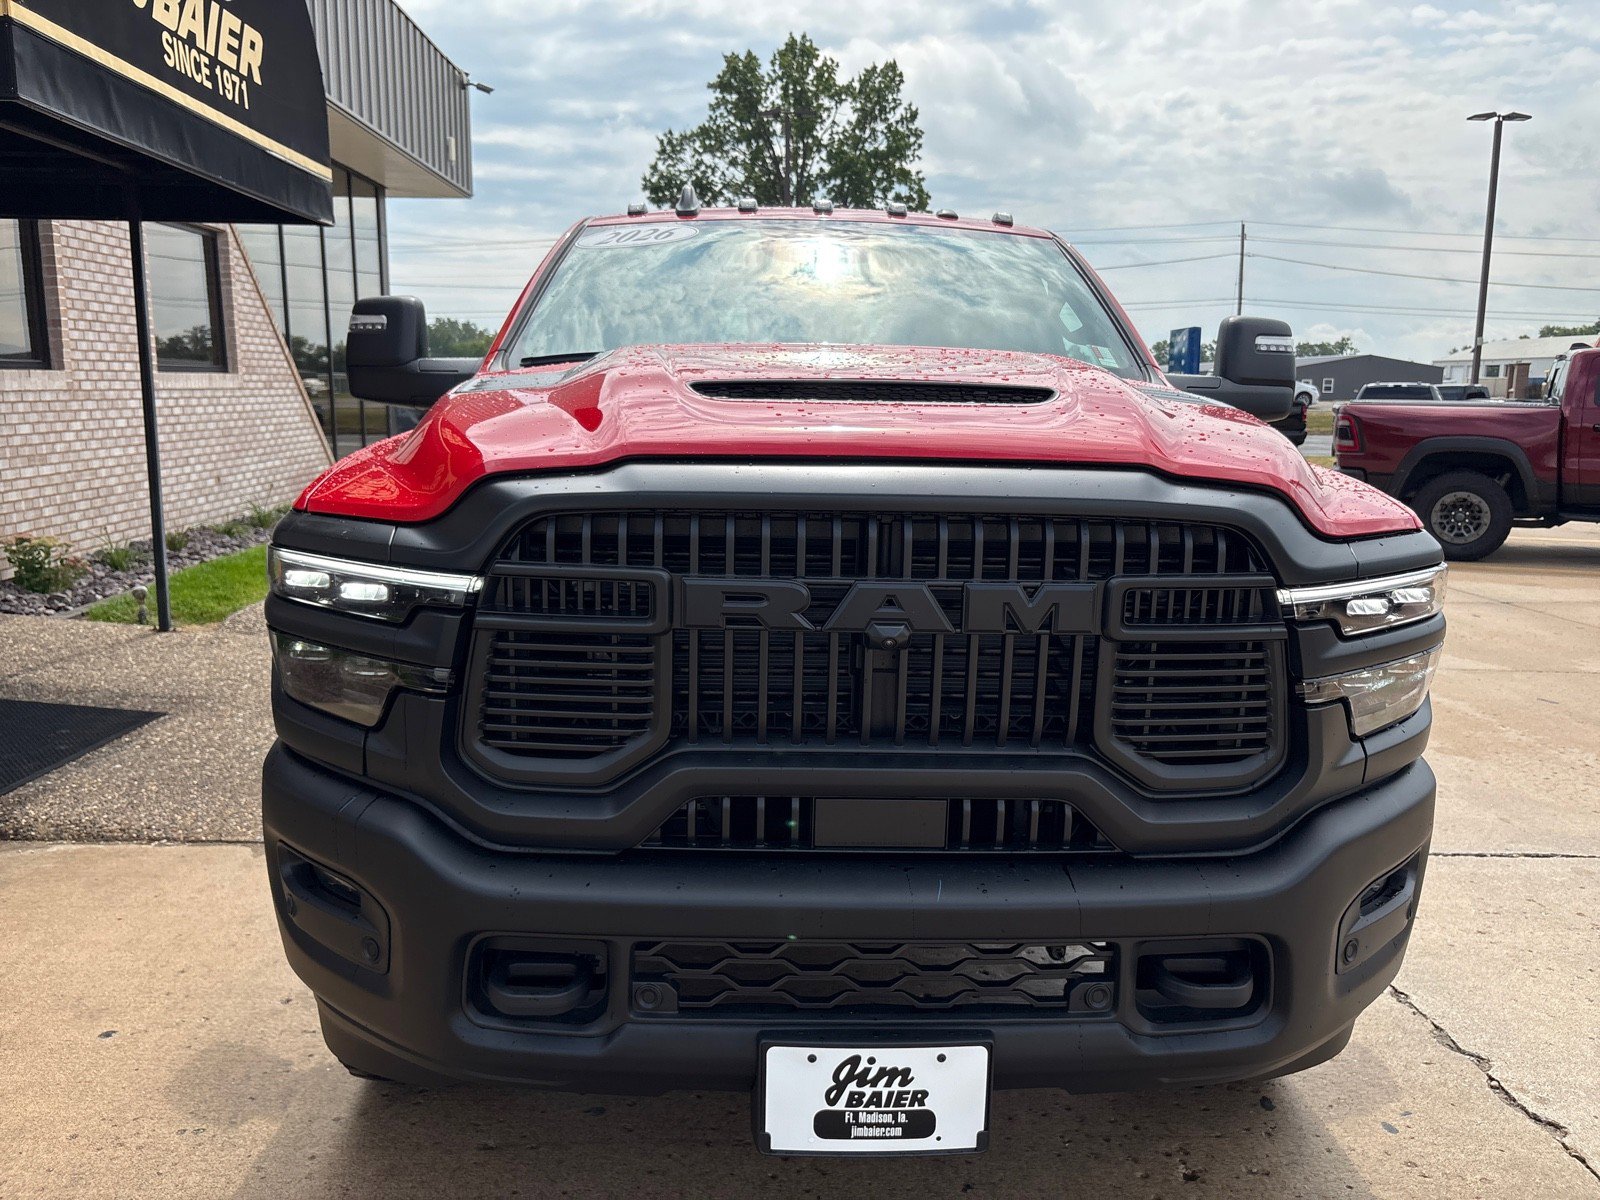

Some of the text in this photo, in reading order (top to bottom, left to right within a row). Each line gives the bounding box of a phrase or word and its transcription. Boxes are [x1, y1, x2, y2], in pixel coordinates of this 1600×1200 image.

[152, 0, 264, 86] BAIER
[161, 30, 249, 110] SINCE 1971
[594, 227, 680, 246] 2026
[681, 576, 1098, 634] RAM
[824, 1054, 915, 1107] Jim
[844, 1089, 930, 1109] BAIER
[845, 1111, 856, 1124] Ft.
[858, 1111, 895, 1125] Madison,
[850, 1125, 903, 1139] jimbaier.com
